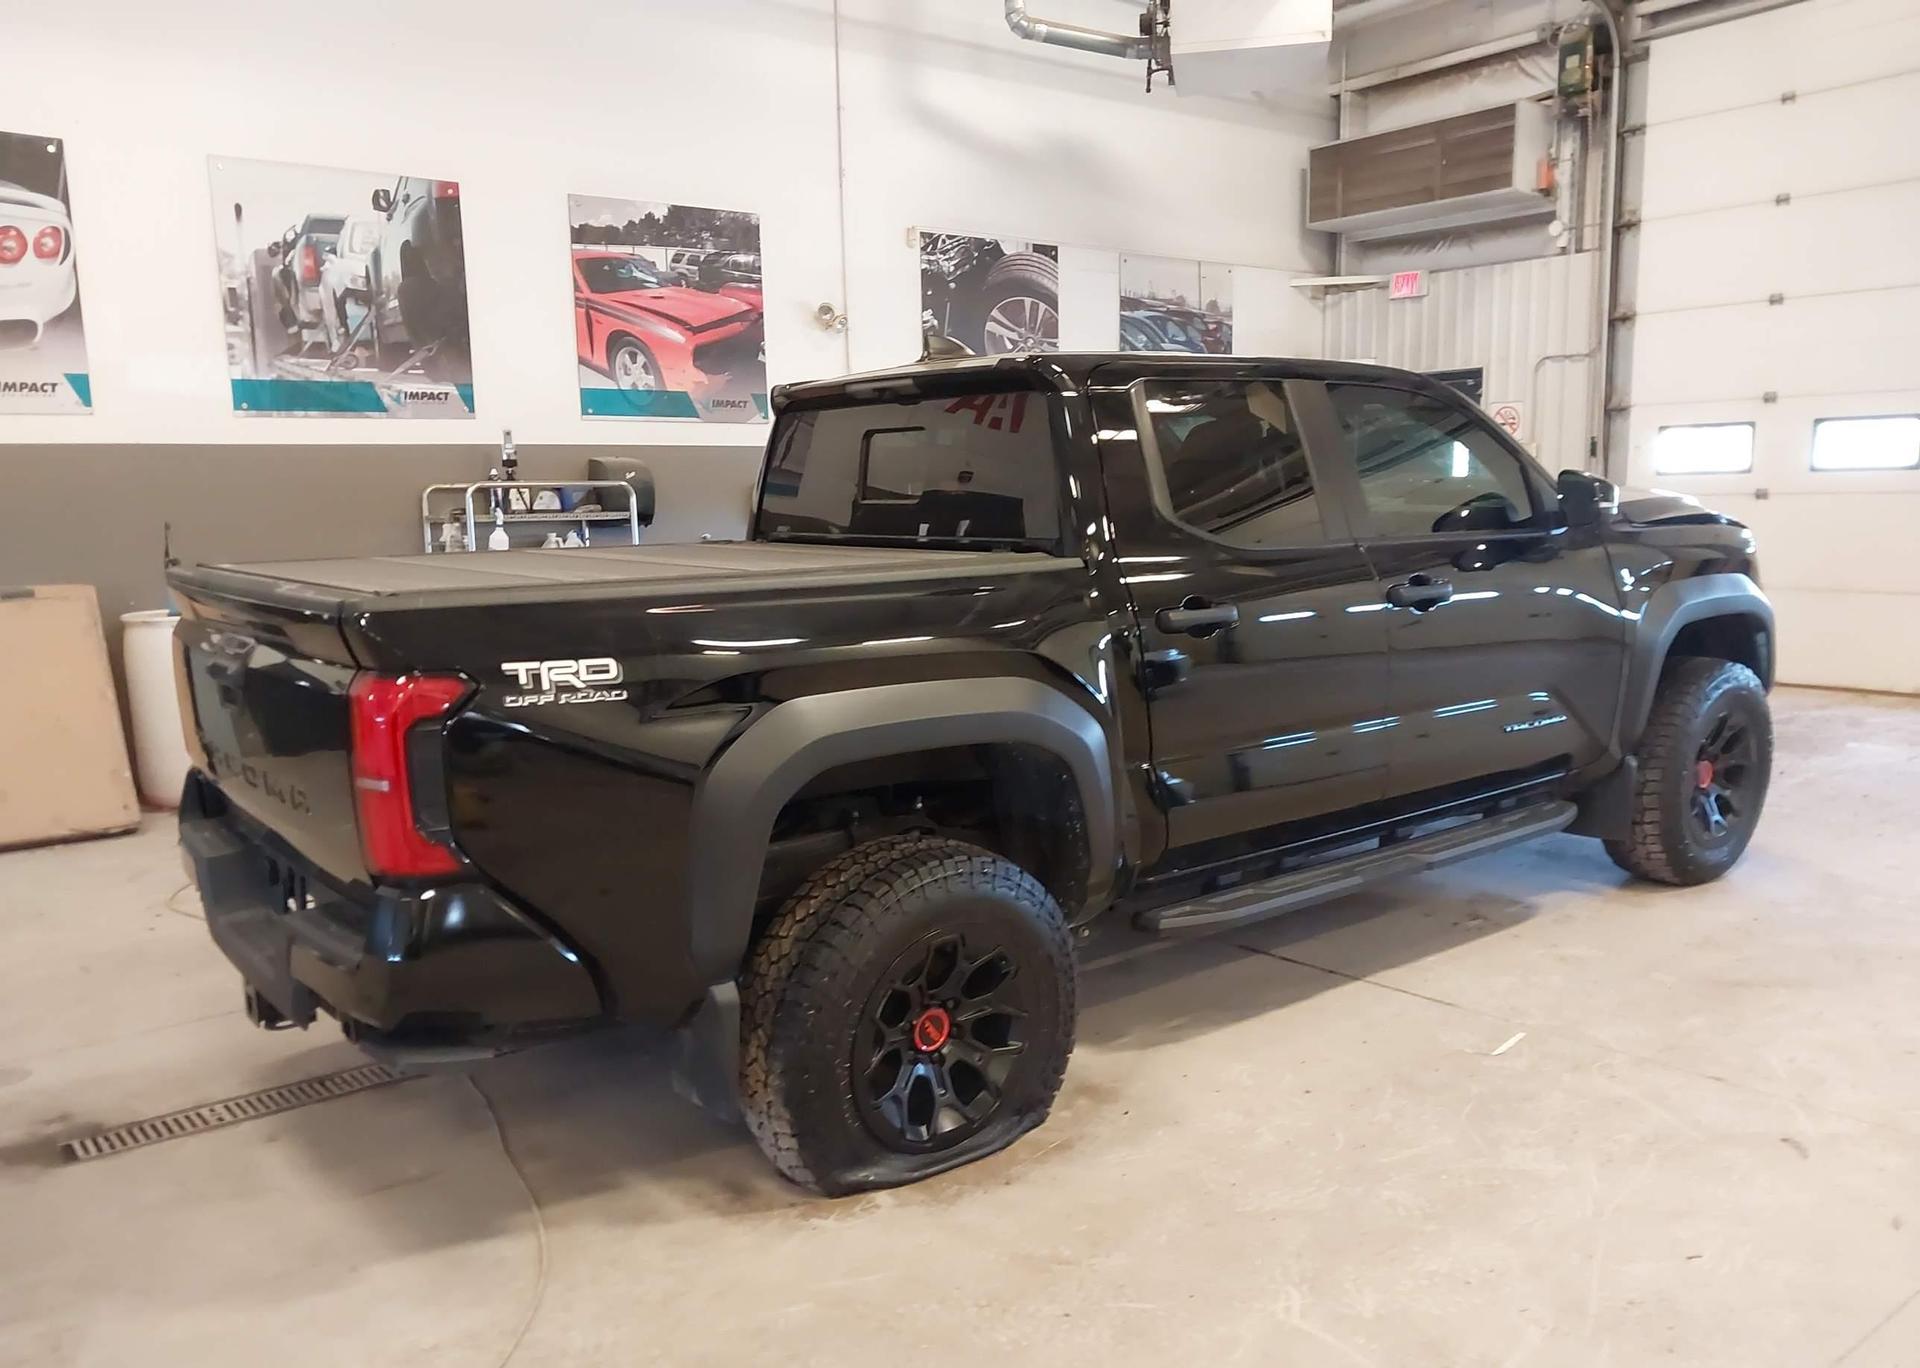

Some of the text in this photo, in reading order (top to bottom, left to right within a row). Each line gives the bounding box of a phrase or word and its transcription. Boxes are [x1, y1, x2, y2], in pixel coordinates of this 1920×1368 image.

[0, 382, 58, 392] MPACT
[404, 391, 450, 401] IMPACT
[712, 399, 748, 409] IMPACT
[501, 657, 620, 692] TRD
[504, 689, 628, 707] OFF ROAD
